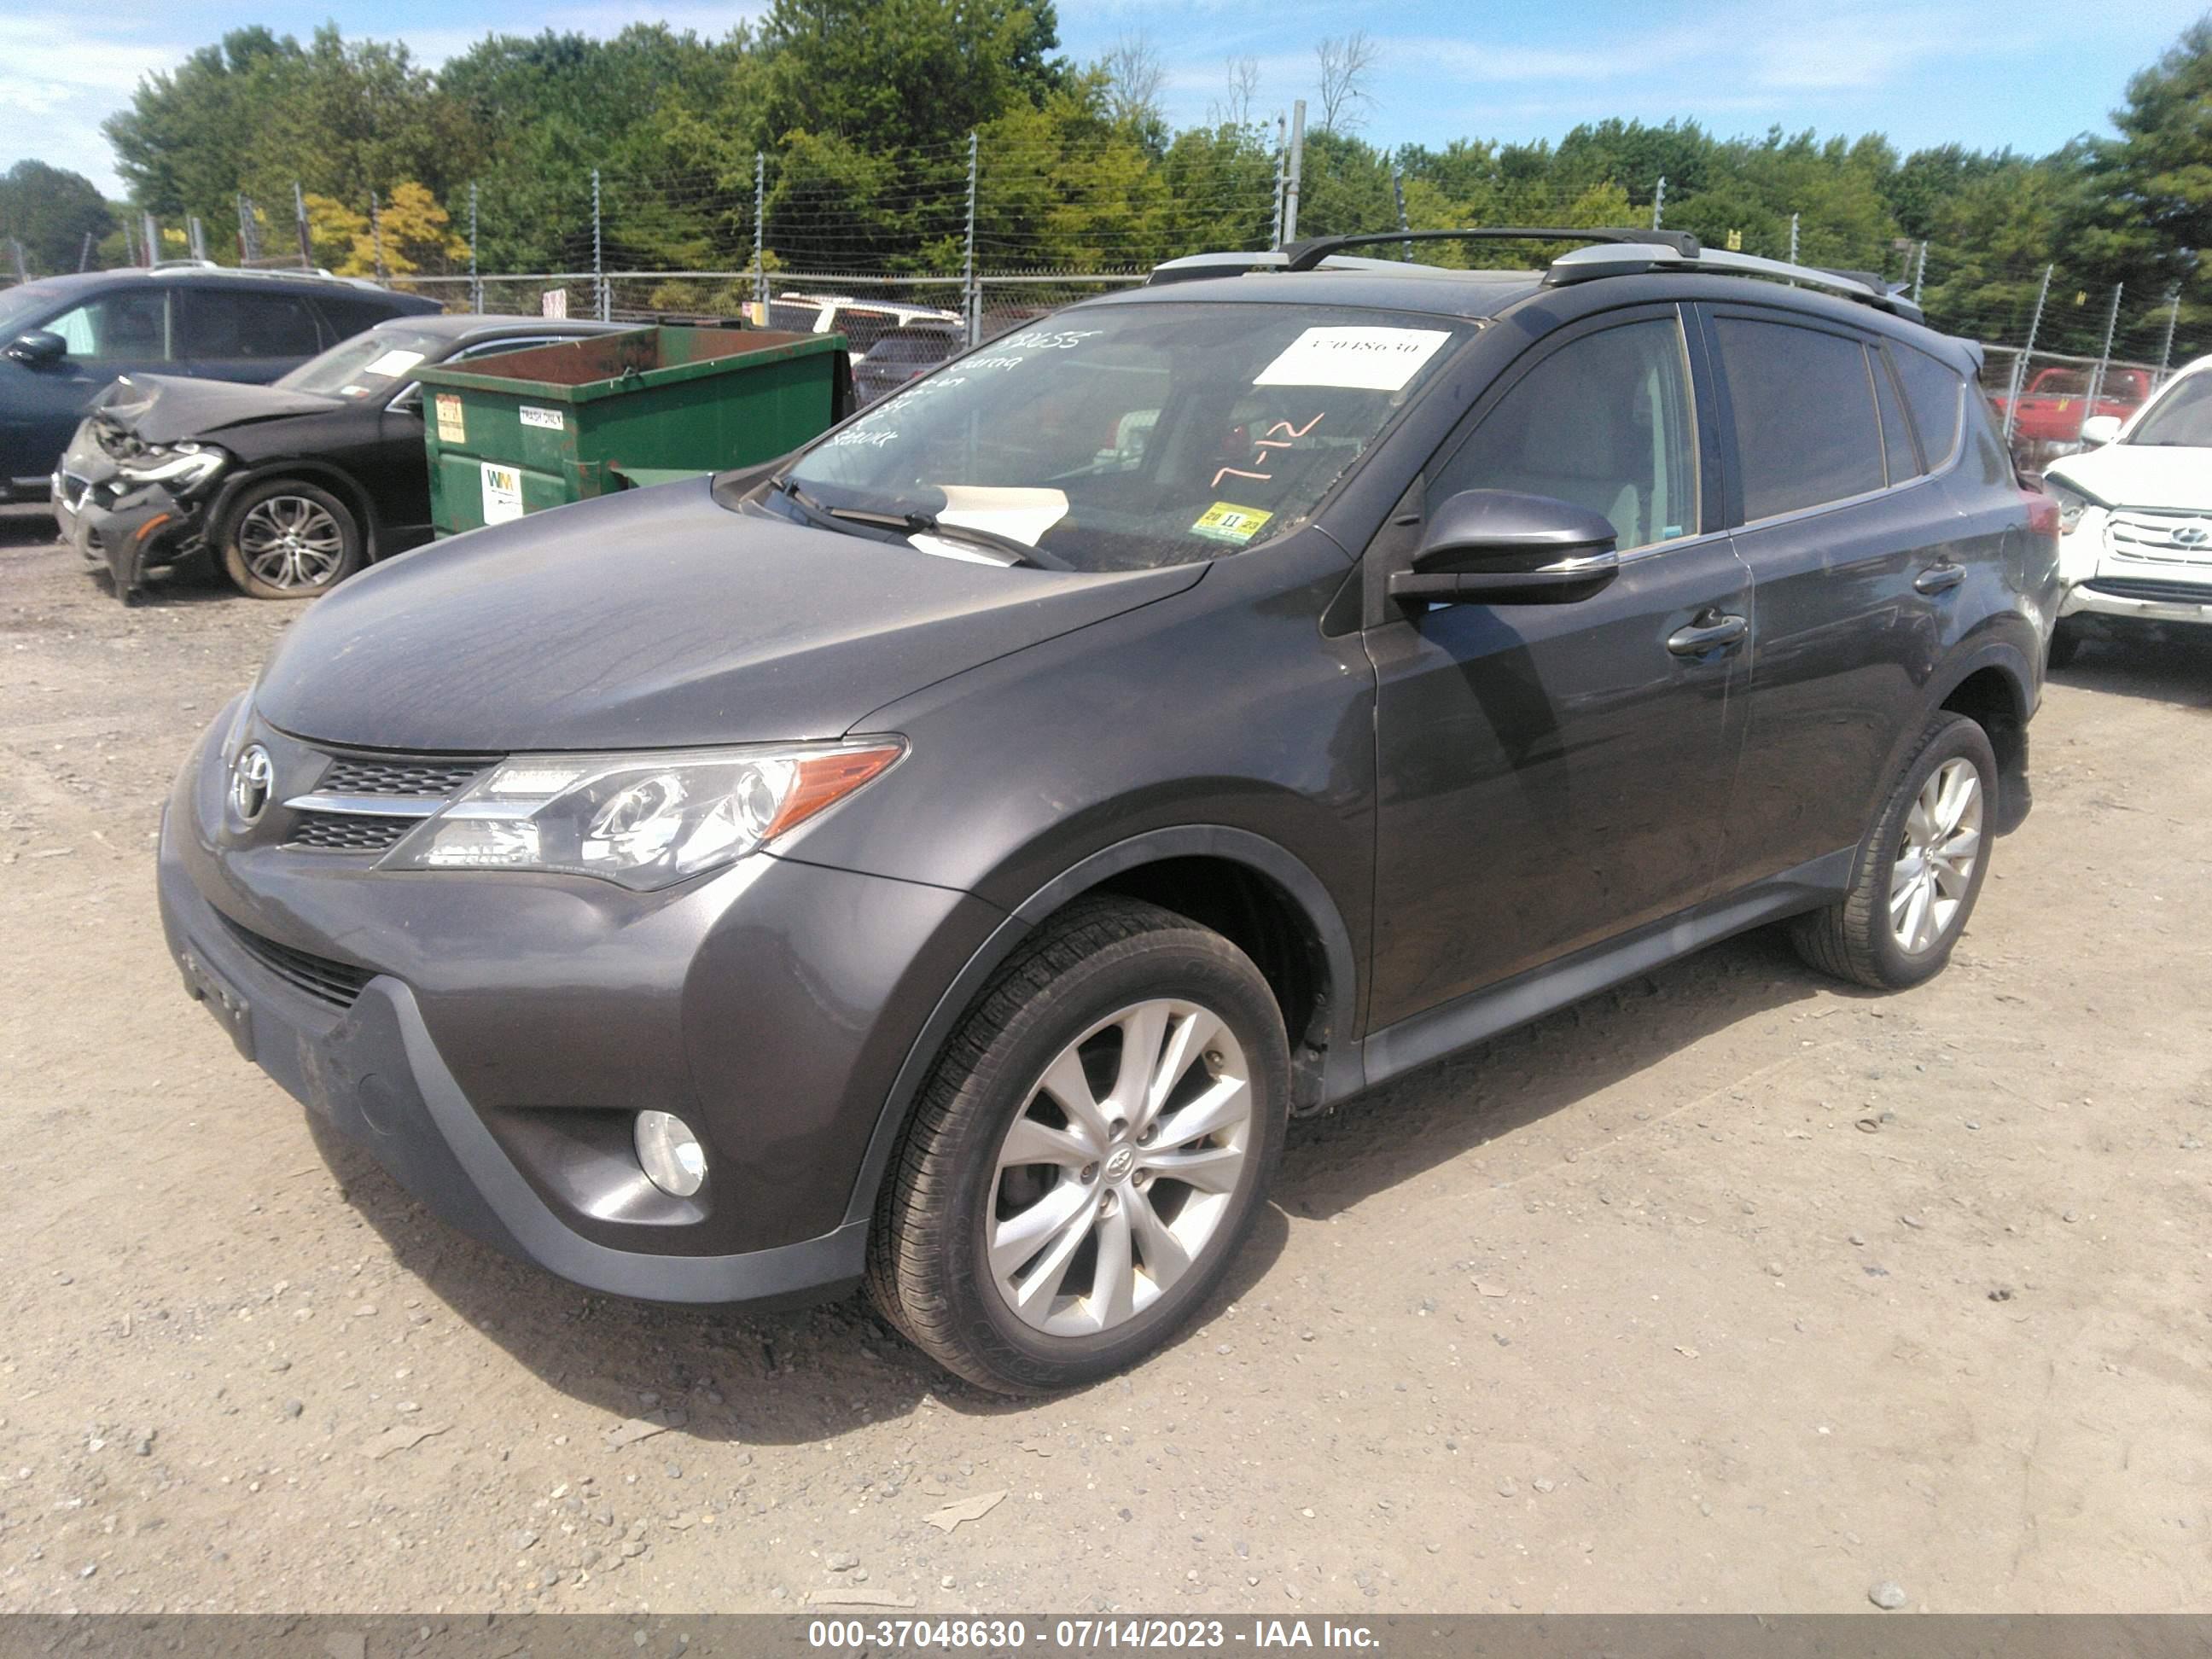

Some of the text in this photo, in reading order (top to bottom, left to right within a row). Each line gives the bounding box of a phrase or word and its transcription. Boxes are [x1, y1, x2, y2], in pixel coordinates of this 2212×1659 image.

[521, 410, 562, 426] TRASH ONLY
[486, 469, 514, 492] WM
[1220, 515, 1242, 527] 11
